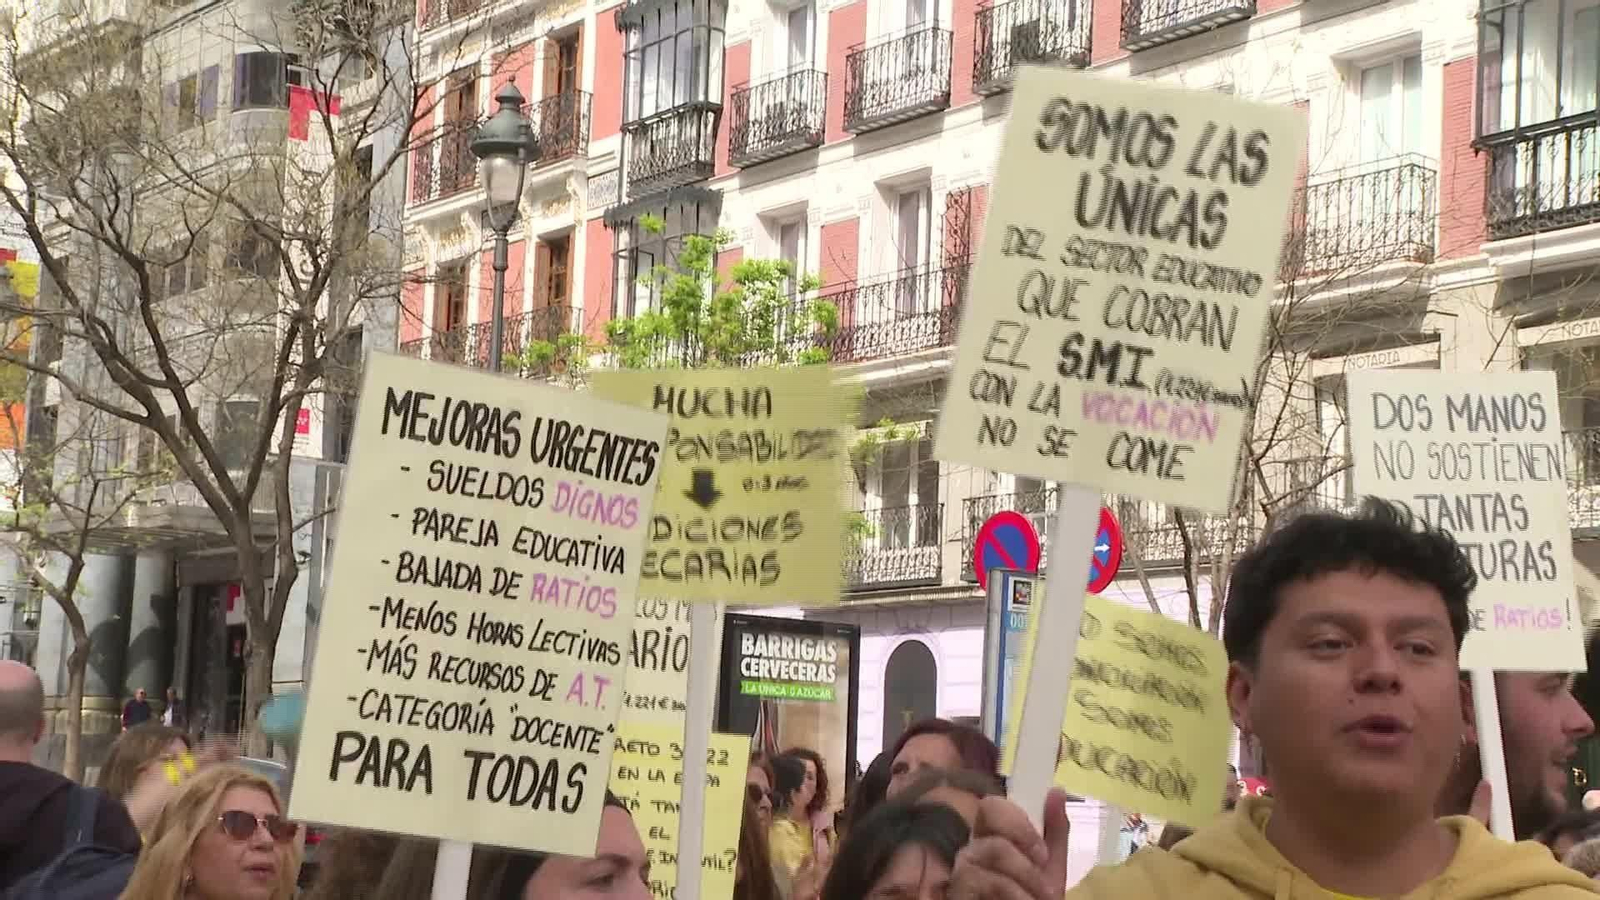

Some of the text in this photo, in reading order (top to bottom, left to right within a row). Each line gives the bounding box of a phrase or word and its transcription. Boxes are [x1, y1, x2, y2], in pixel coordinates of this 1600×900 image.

[1034, 96, 1270, 187] SOMOS LAS
[1001, 224, 1263, 298] DEL SECTOR EDUCATIVO
[1016, 269, 1240, 352] QUE COBRAN
[983, 320, 1030, 370] EL
[653, 385, 773, 419] MUCHA
[969, 368, 1017, 407] CON
[1027, 380, 1061, 418] LA
[1371, 392, 1547, 433] DOS MANOS
[381, 386, 660, 487] MEJORAS URGENTES
[977, 414, 1195, 480] NO SE COME
[1374, 437, 1562, 482] NO SOSTIENEN
[427, 459, 545, 508] SUELDOS
[550, 480, 640, 530] DIGNOS
[1414, 493, 1530, 534] TANTAS
[411, 507, 499, 548] PAREJA
[511, 526, 626, 574] EDUCATIVA
[488, 567, 524, 600] DE
[530, 572, 618, 619] RATIOS
[466, 612, 524, 649] HORAS
[528, 619, 622, 666] LECTIVAS
[741, 632, 838, 663] BARRIGAS
[427, 651, 526, 693] RECURSOS
[529, 670, 559, 701] DE
[566, 671, 611, 712] A.T.
[740, 657, 837, 683] CERVECERAS
[329, 730, 588, 814] PARA TODAS
[618, 766, 639, 781] EN
[648, 769, 666, 782] LA
[649, 826, 670, 841] EL
